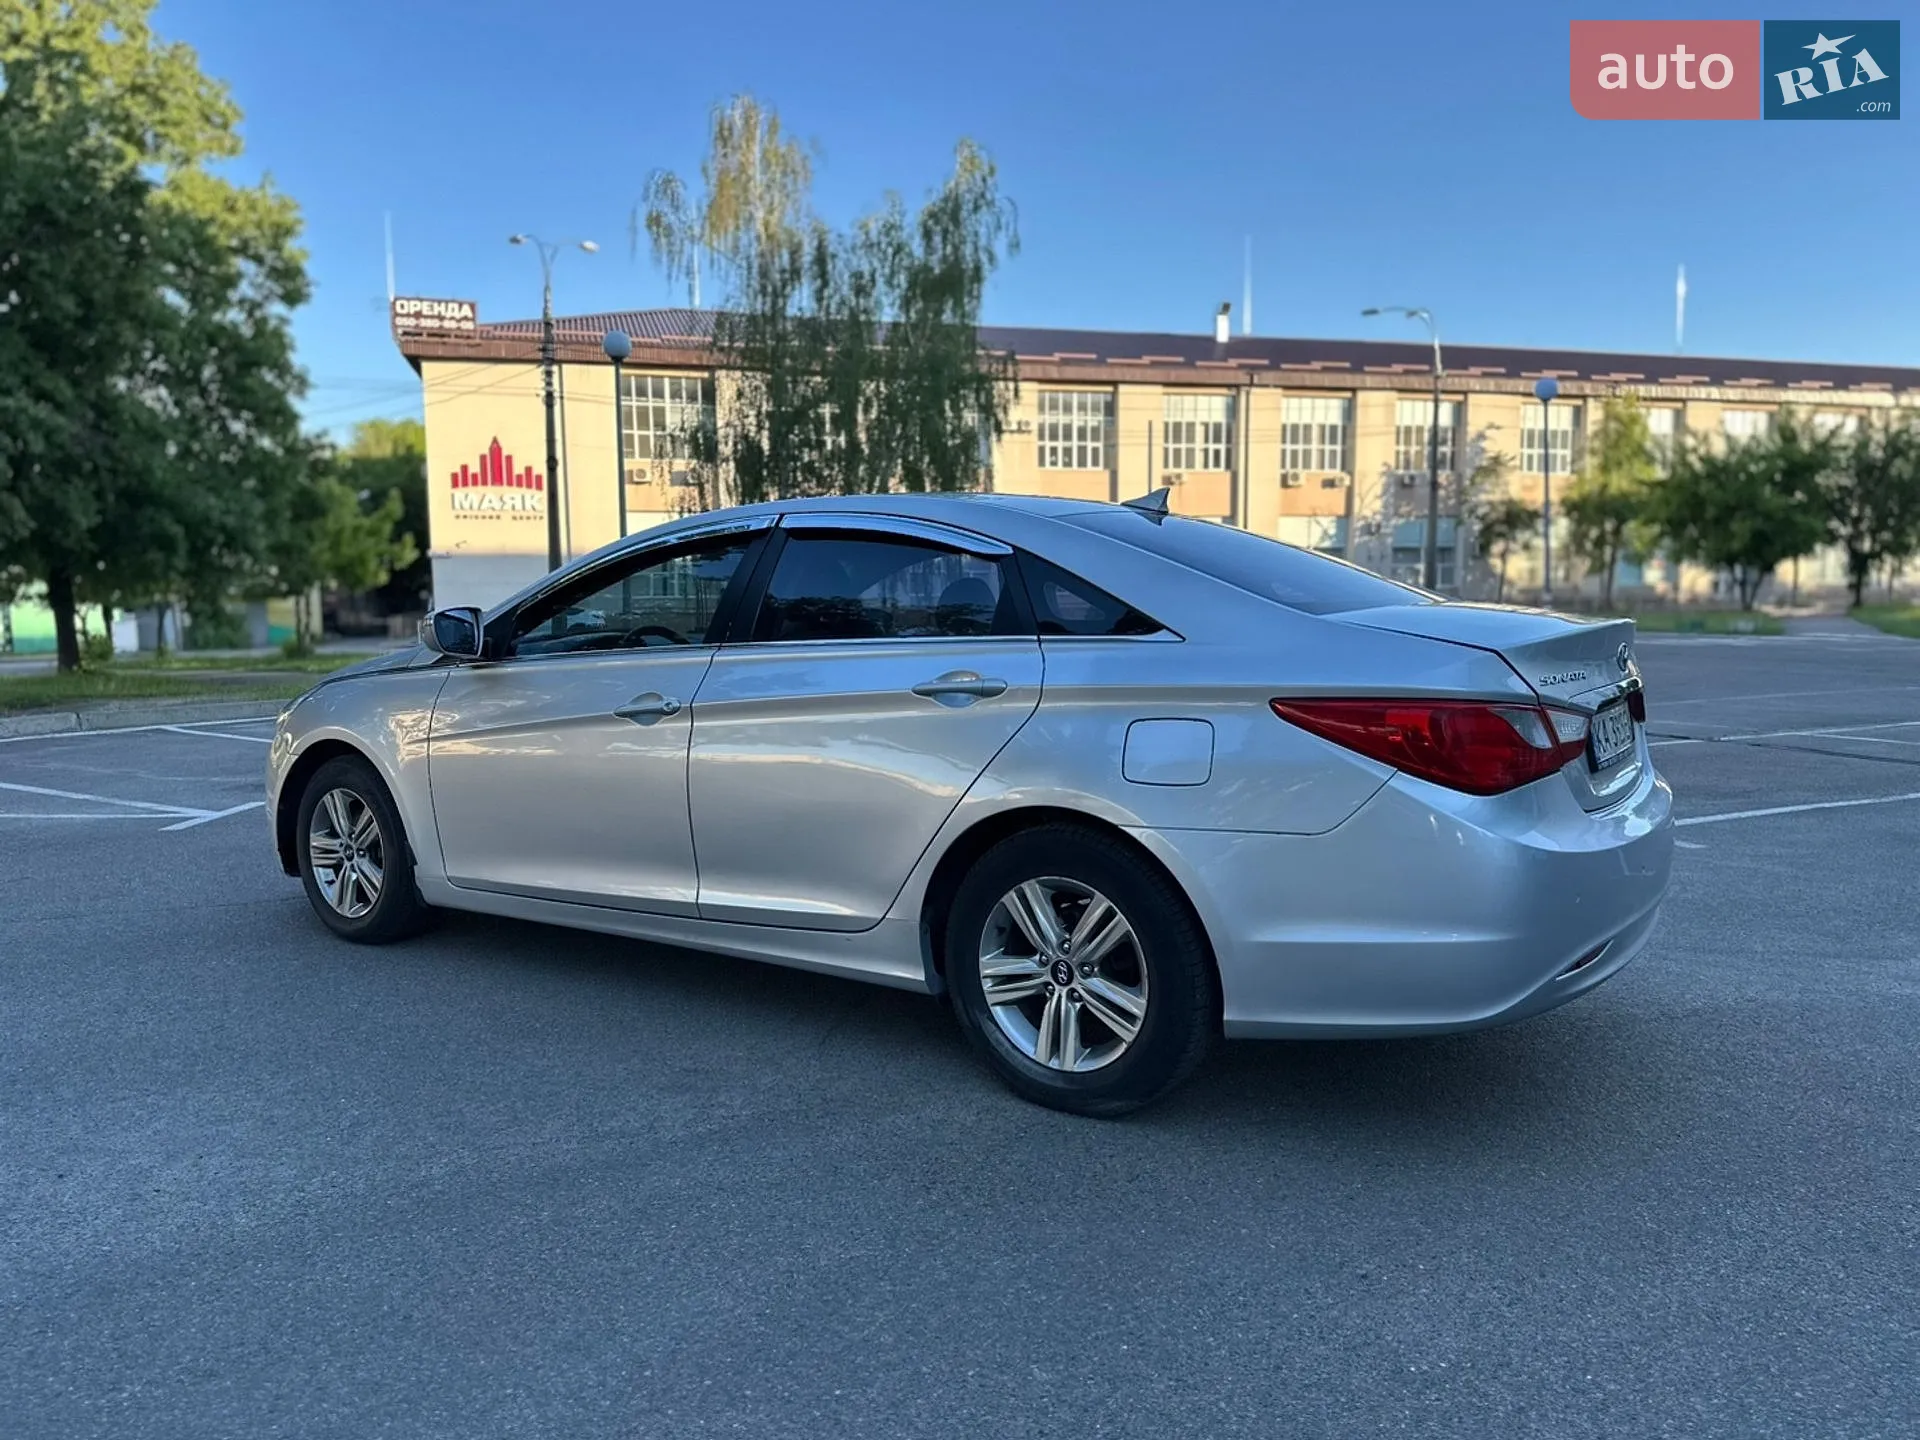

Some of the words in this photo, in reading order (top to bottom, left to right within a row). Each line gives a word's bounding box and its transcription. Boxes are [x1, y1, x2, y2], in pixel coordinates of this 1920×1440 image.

[395, 299, 474, 319] ОРЕНДА
[451, 492, 544, 512] МАЯК
[1539, 670, 1587, 687] SONATA
